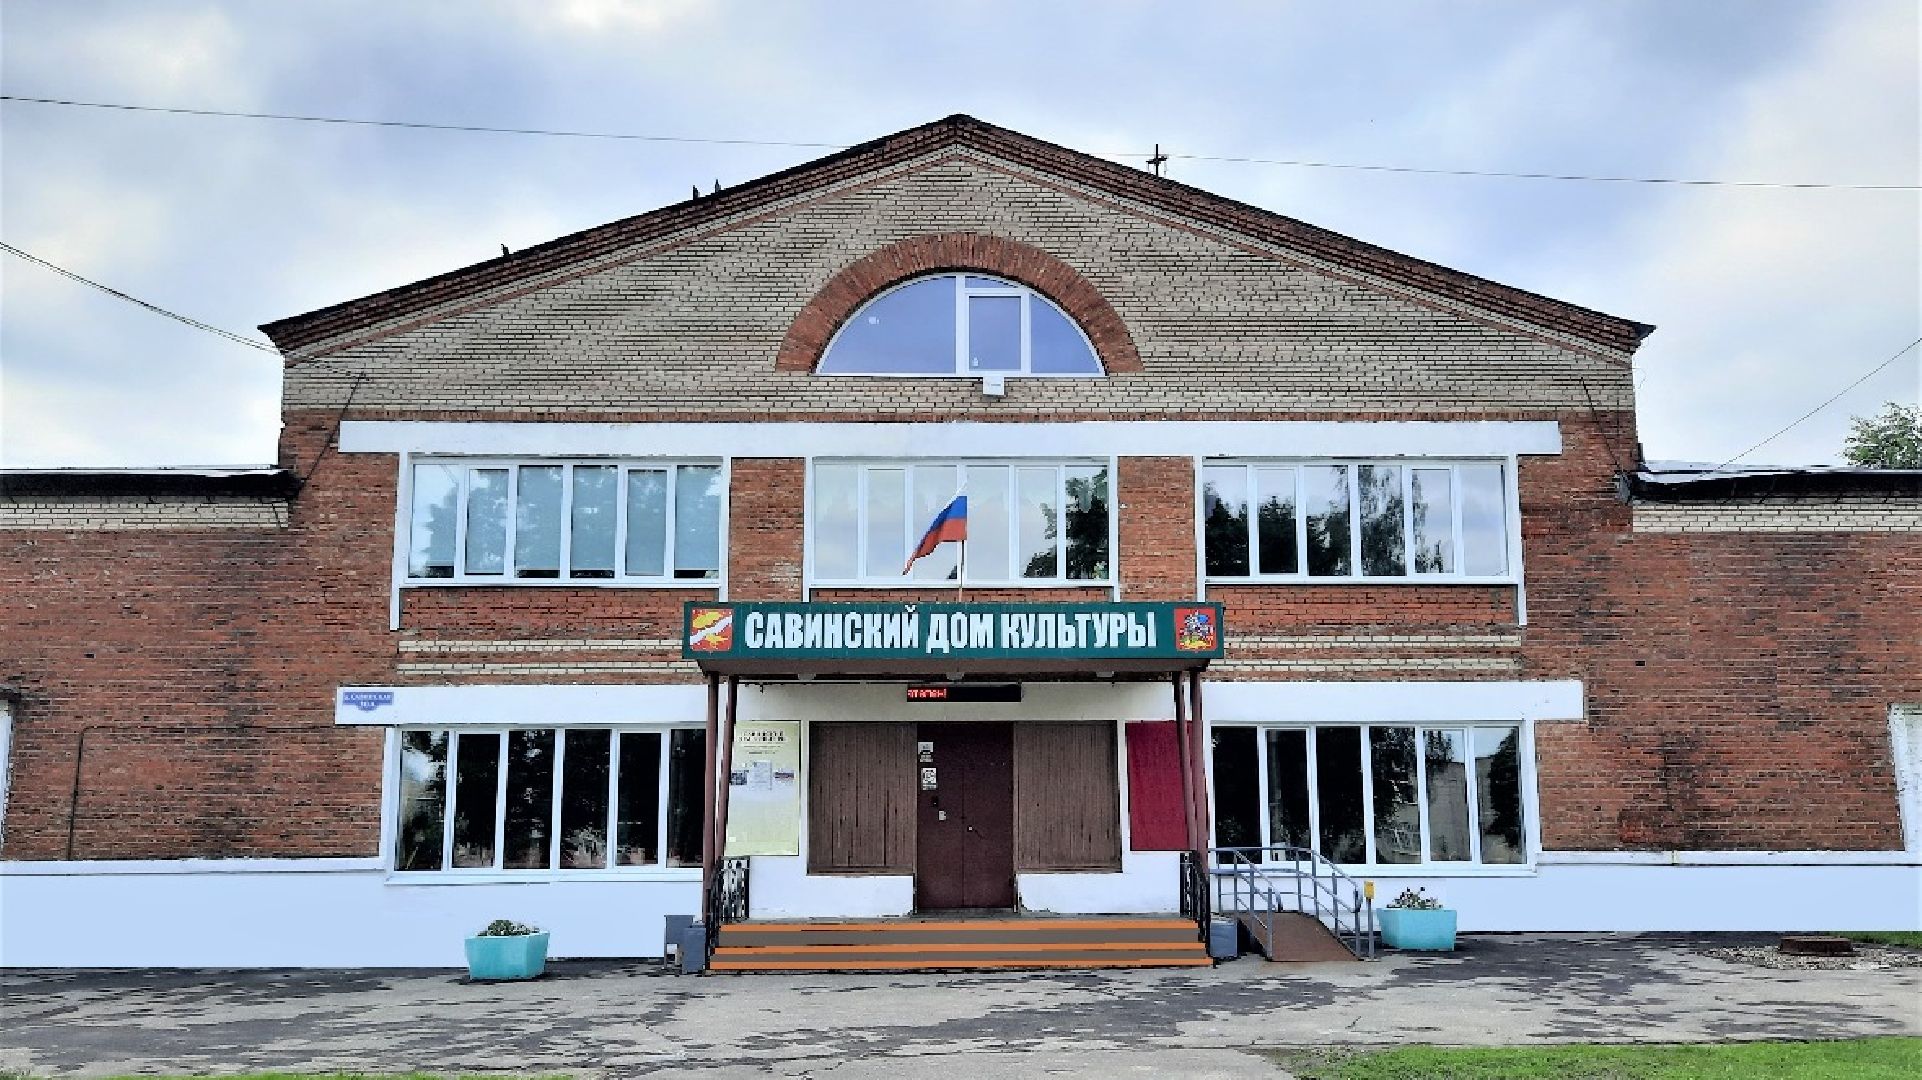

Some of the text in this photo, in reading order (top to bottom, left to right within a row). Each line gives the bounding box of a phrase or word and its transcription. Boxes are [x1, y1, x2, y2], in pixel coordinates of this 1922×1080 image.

[744, 604, 1157, 654] САВИНСКИЙ ДОМ КУЛЬТУРЫ
